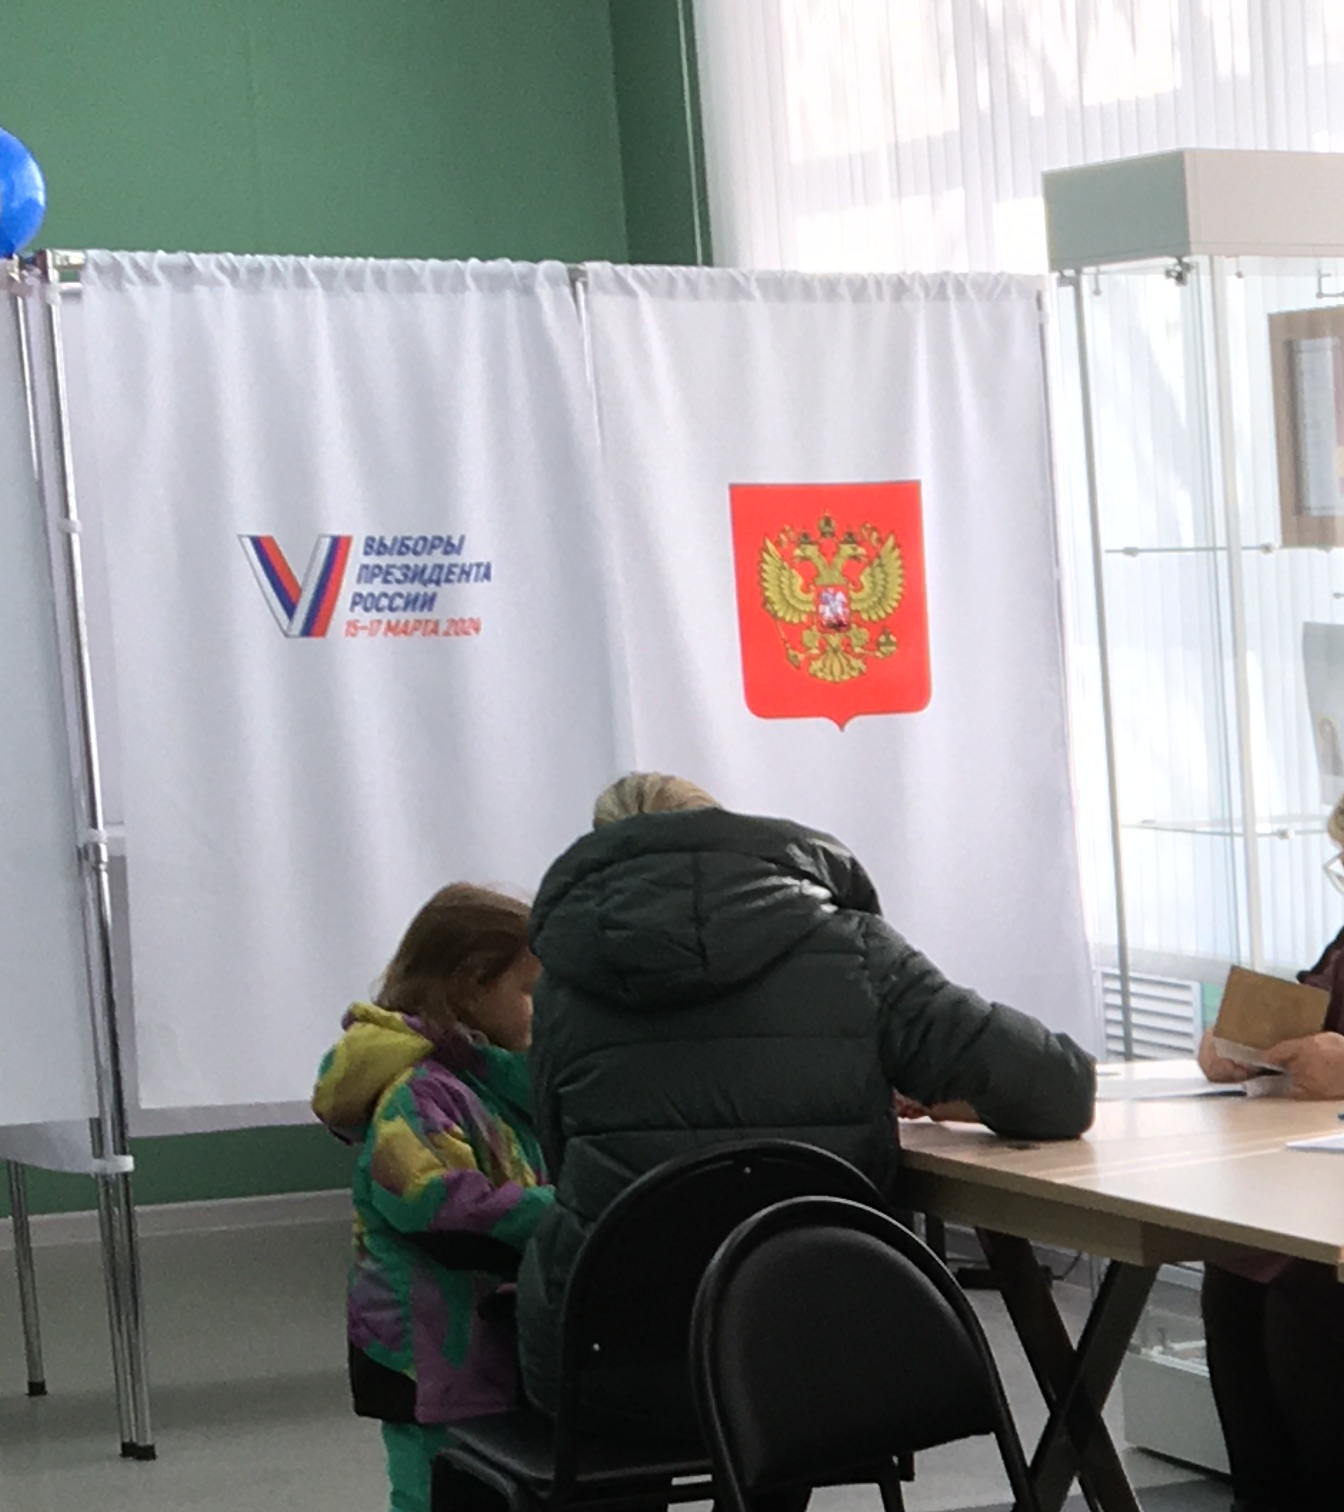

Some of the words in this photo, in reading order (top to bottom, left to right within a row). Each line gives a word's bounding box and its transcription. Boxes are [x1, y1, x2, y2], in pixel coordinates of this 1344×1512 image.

[362, 535, 466, 556] ВЫБОРЫ
[355, 561, 492, 587] ПРЕЗИДЕНТА
[349, 592, 437, 613] РОССИИ
[384, 618, 439, 637] МАРТА
[442, 617, 481, 636] 2024
